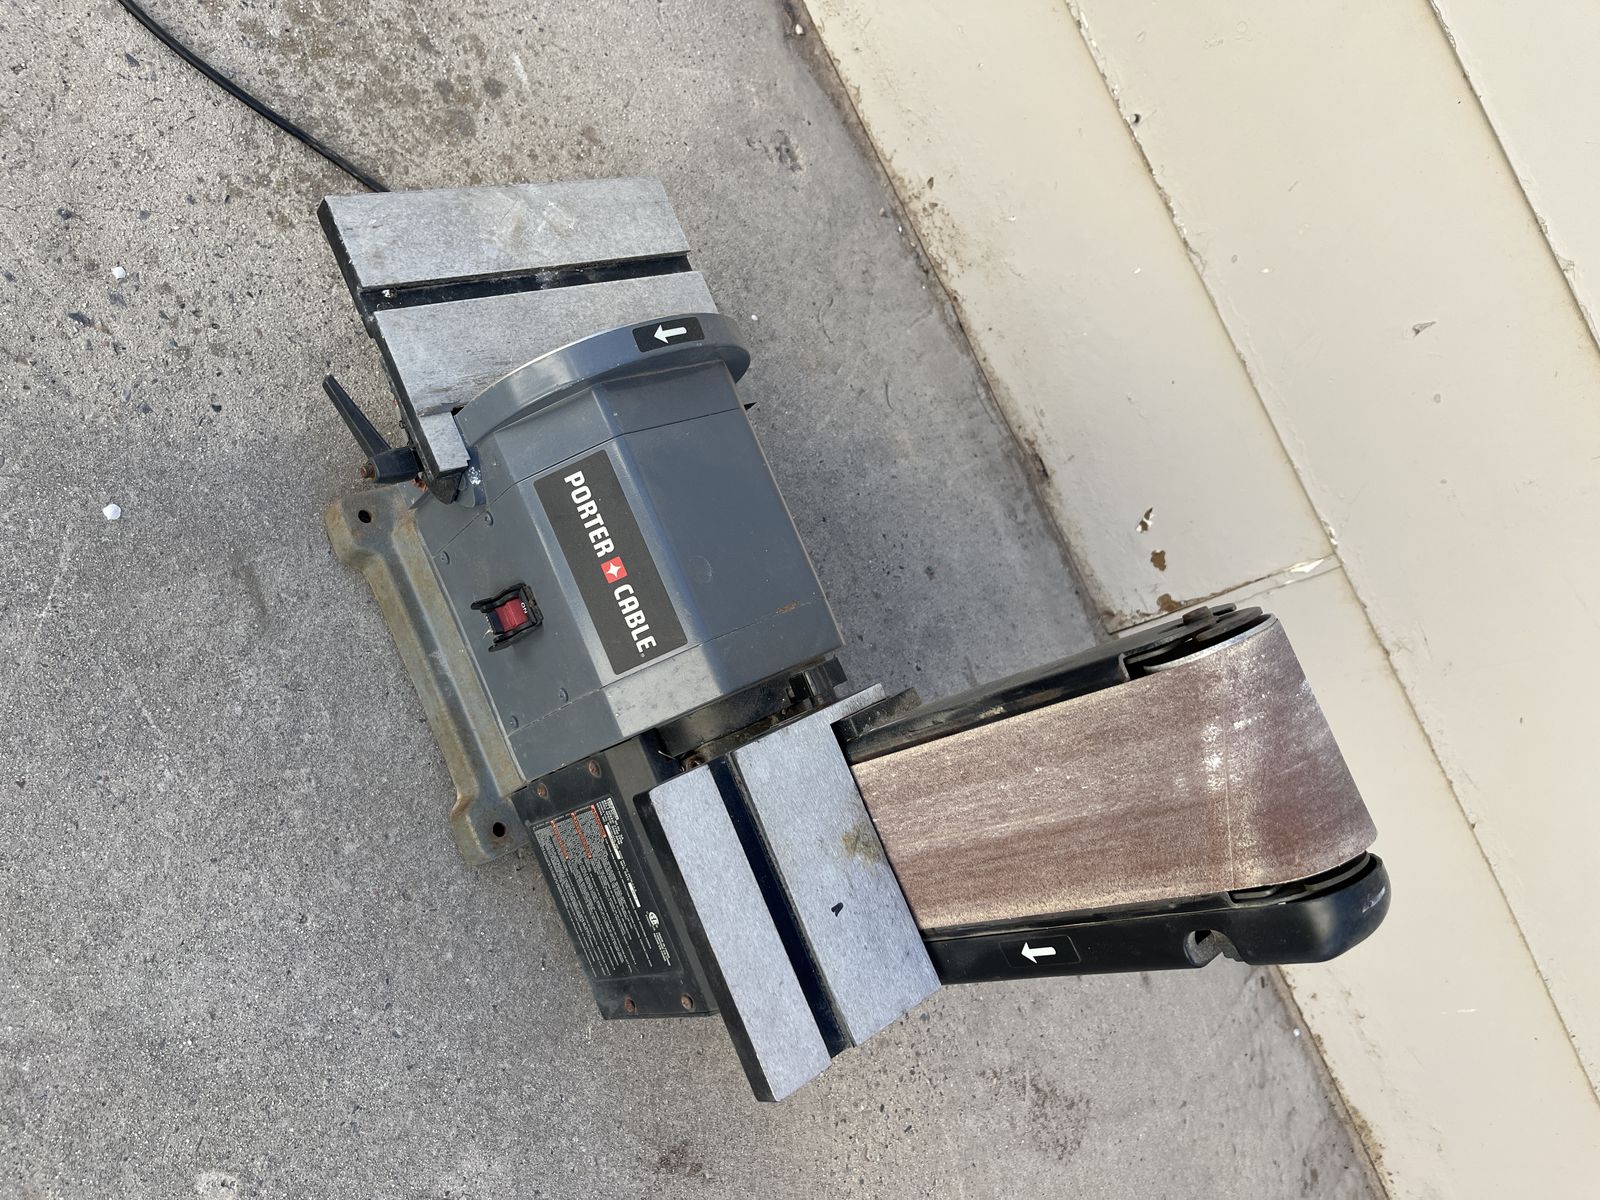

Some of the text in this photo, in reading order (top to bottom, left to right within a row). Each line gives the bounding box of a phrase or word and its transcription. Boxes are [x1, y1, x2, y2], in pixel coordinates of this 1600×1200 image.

[520, 602, 528, 614] ON
[563, 470, 657, 654] PORTER CABLE
